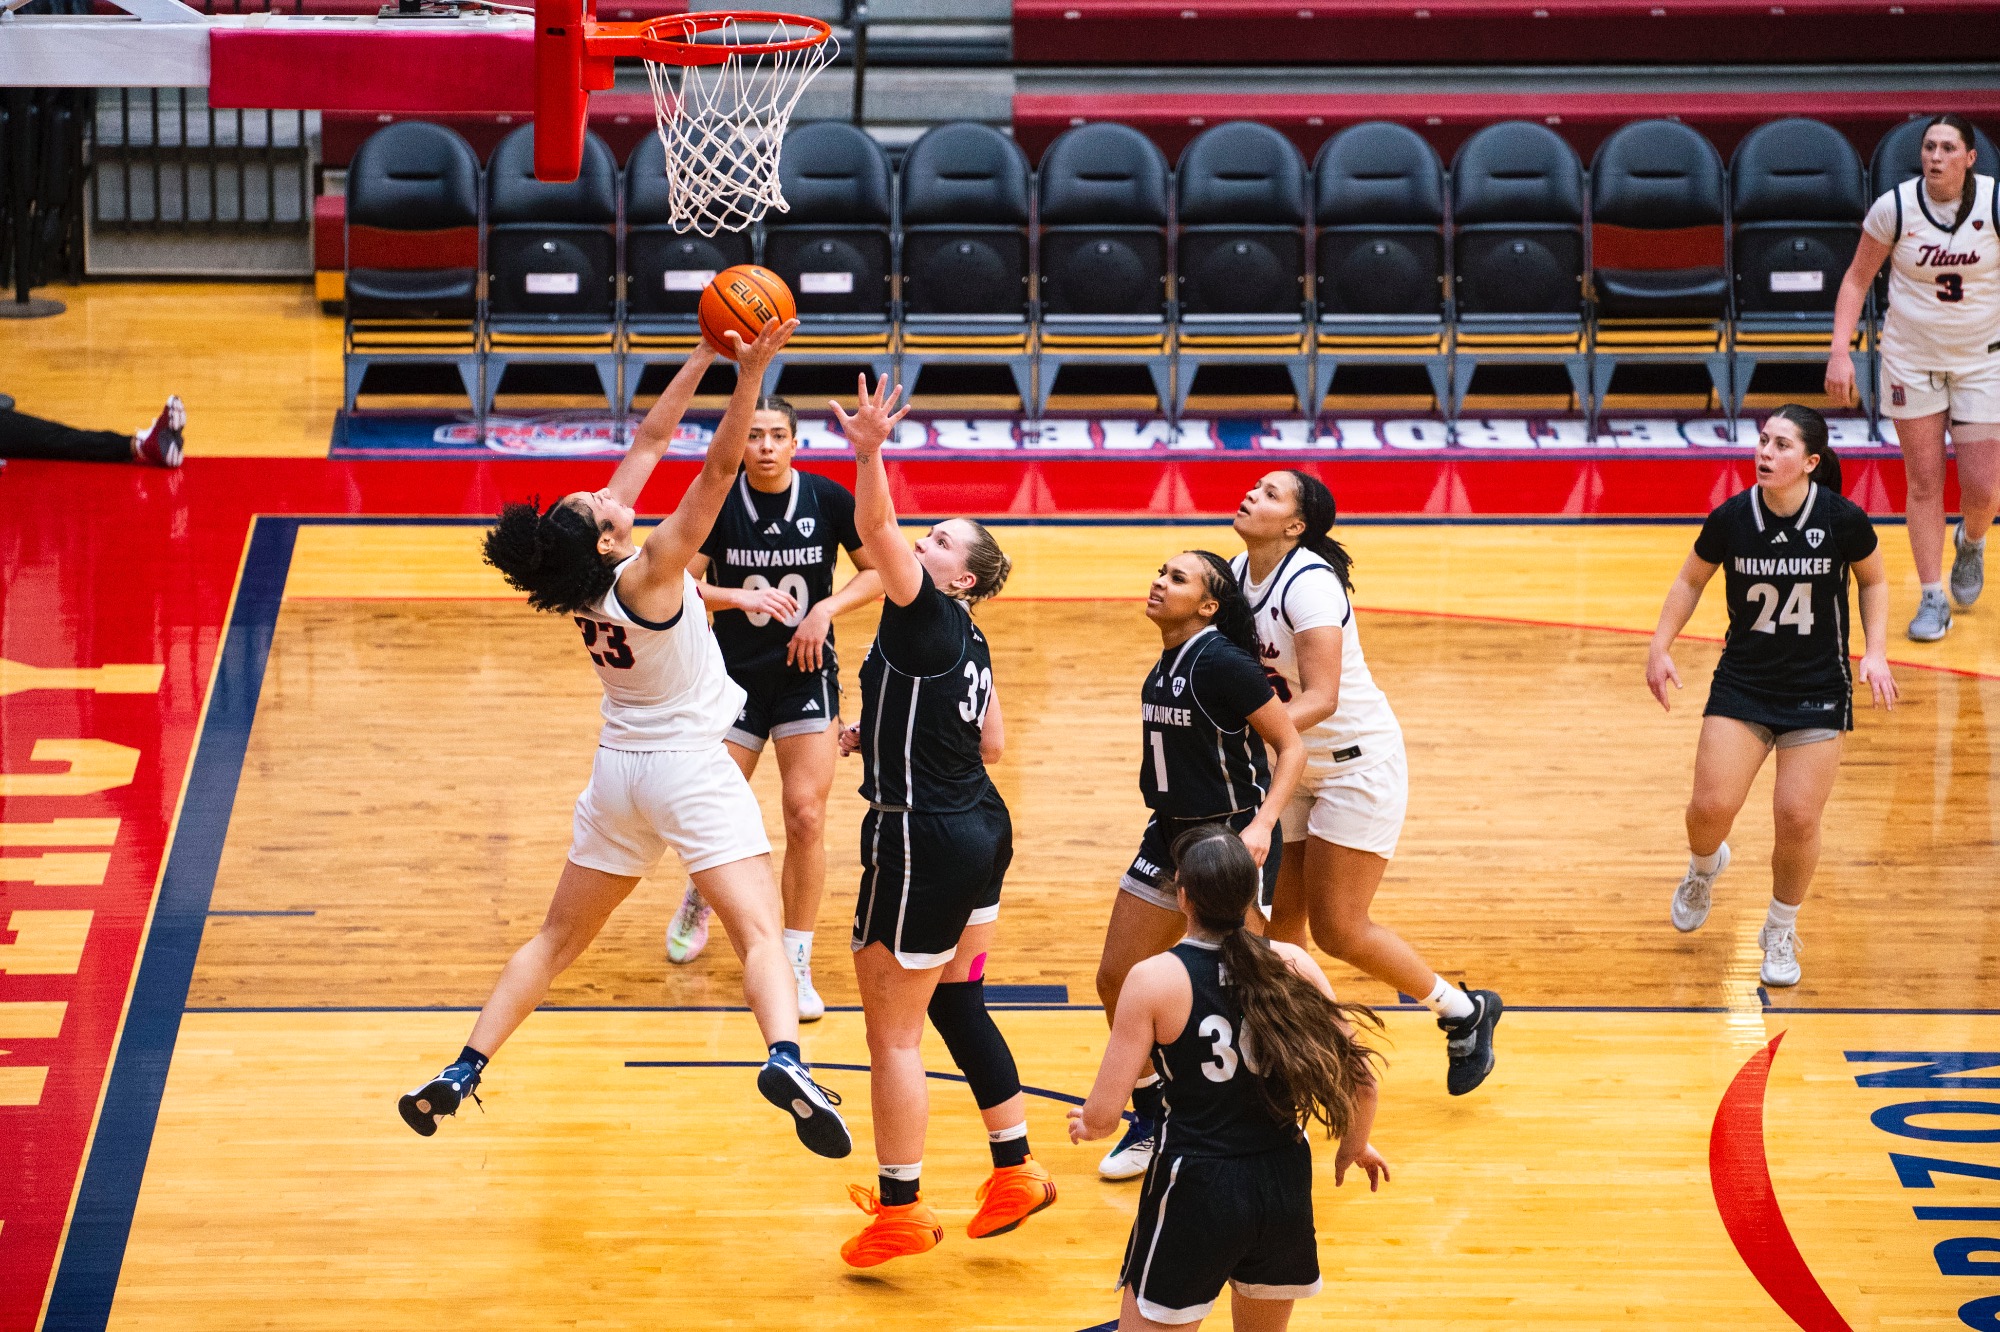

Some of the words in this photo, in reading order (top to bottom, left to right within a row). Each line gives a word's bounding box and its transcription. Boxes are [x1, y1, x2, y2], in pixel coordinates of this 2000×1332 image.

[1916, 244, 1980, 267] Titans
[1935, 273, 1964, 302] 3
[1258, 419, 1758, 449] DETROIT
[726, 546, 823, 567] MILWAUKEE
[1734, 556, 1832, 576] MILWAUKEE
[1747, 583, 1815, 635] 24
[575, 616, 635, 669] 23
[959, 661, 993, 730] 32
[1150, 731, 1168, 792] 1
[1133, 856, 1161, 878] MKE
